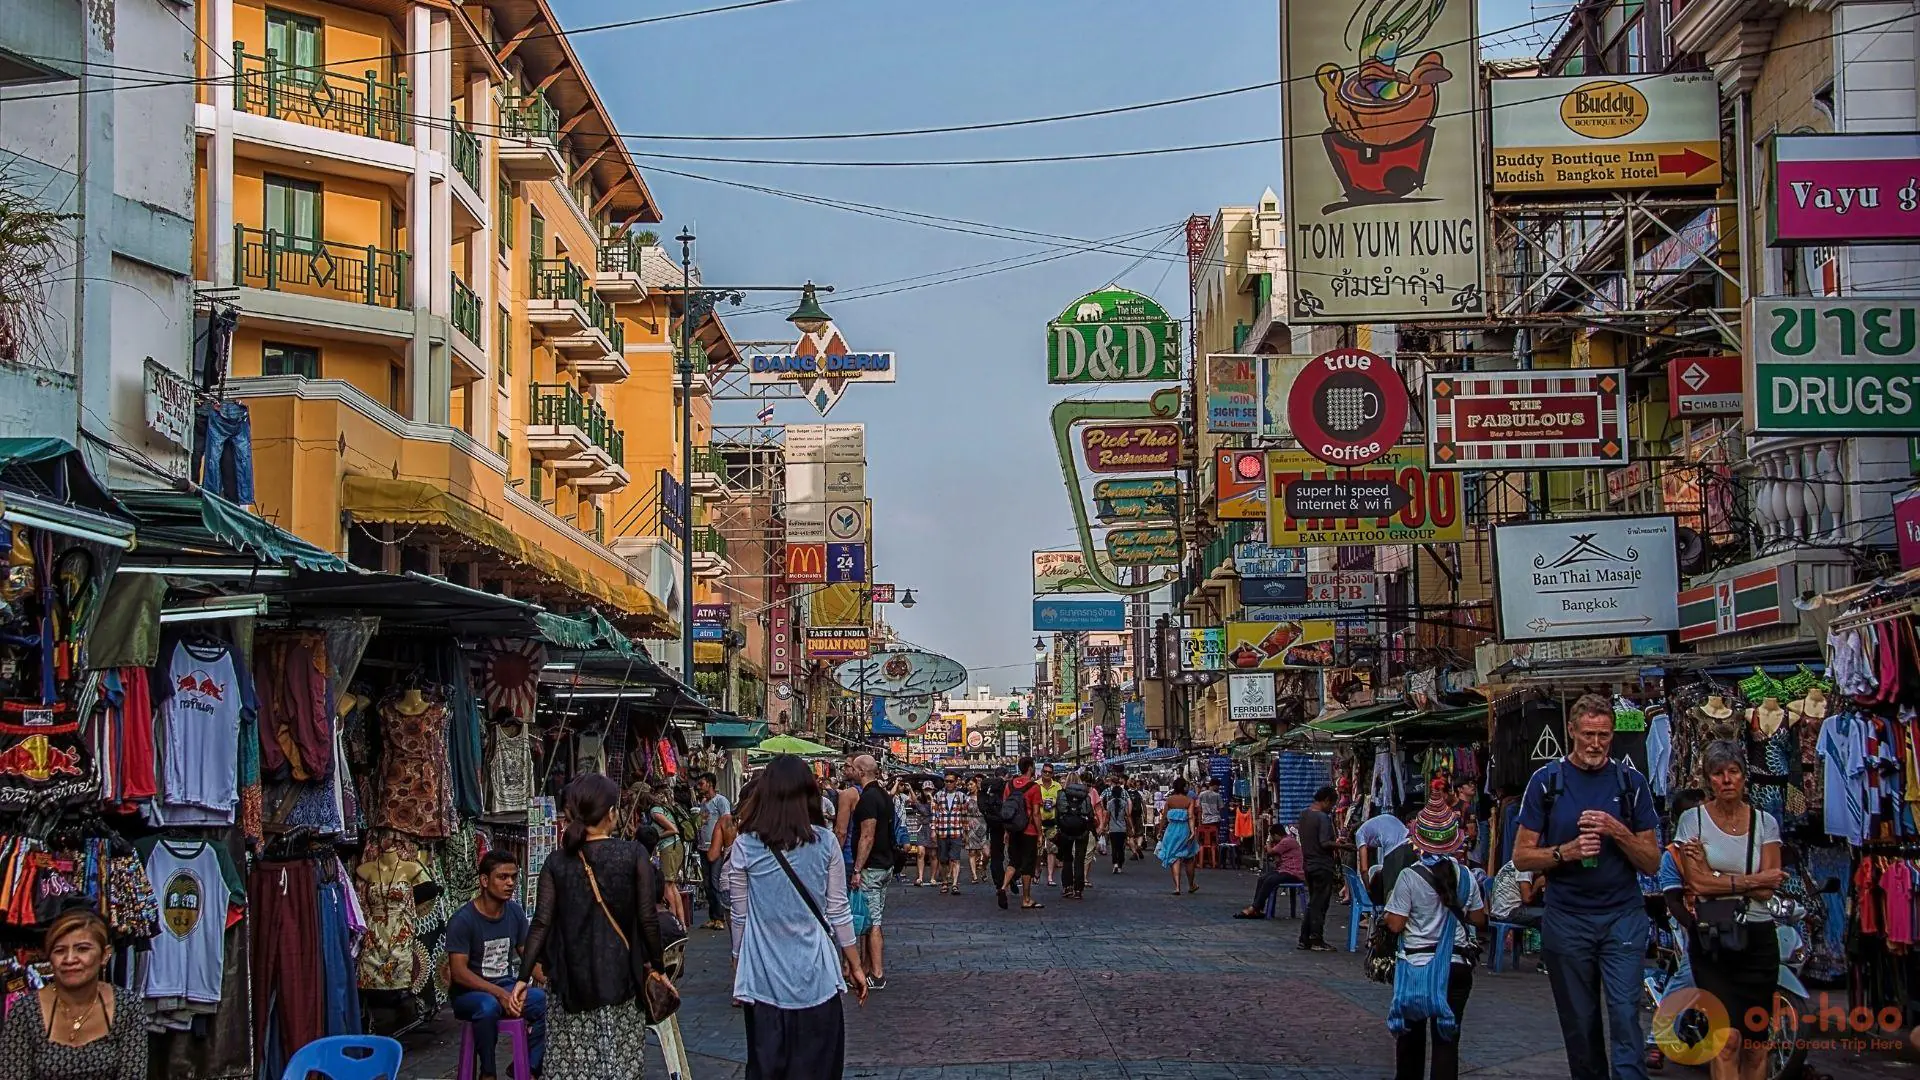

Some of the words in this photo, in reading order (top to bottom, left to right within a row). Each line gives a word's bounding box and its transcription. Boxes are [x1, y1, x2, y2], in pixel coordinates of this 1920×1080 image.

[1575, 91, 1635, 117] Buddy
[1575, 118, 1617, 127] BOUTIQUE
[1620, 118, 1635, 126] INN
[1496, 154, 1545, 168] Buddy
[1551, 152, 1621, 168] Boutique
[1628, 151, 1655, 163] Inn
[1496, 171, 1545, 183] Modish
[1557, 168, 1615, 183] Bangkok
[1621, 167, 1658, 179] Hotel
[1790, 181, 1880, 214] Vayu
[1898, 177, 1920, 211] g
[1298, 223, 1345, 260] TOM
[1352, 221, 1400, 258] YUM
[1409, 218, 1474, 256] KUNG
[1331, 266, 1445, 306] ต้มยำกุ้ง
[1117, 305, 1129, 315] The
[1131, 305, 1144, 315] best
[1770, 307, 1916, 357] ขาย
[1053, 325, 1156, 380] D&D
[1163, 324, 1177, 374] INN
[753, 355, 817, 372] DANG
[827, 353, 890, 372] DERM
[1324, 355, 1371, 371] true
[780, 371, 818, 379] Authentic
[1229, 395, 1250, 405] JOIN
[1772, 376, 1920, 415] DRUGS
[1213, 407, 1241, 417] SIGHT
[1509, 400, 1542, 411] THE
[1693, 400, 1718, 409] CIMB
[1719, 400, 1740, 409] THAI
[1467, 412, 1586, 428] FABULOUS
[1087, 429, 1178, 449] Pick-Thai
[1099, 449, 1169, 465] Restaurant
[1321, 441, 1381, 461] coffee
[1296, 486, 1332, 498] super
[1335, 484, 1347, 496] hi
[1351, 484, 1389, 498] speed
[1296, 498, 1346, 510] internet
[1350, 499, 1359, 510] &
[1364, 499, 1379, 510] wi
[1384, 498, 1392, 509] fi
[1299, 532, 1326, 543] EAK
[1330, 531, 1385, 542] TATTOO
[1389, 529, 1436, 541] GROUP
[837, 556, 854, 569] 24
[1036, 554, 1082, 565] CENTER
[1037, 564, 1072, 578] Khao
[1532, 572, 1557, 586] Ban
[1560, 568, 1590, 585] Thai
[1596, 566, 1642, 585] Masaje
[1320, 588, 1331, 600] &
[1307, 601, 1333, 609] SILVER
[1334, 600, 1352, 608] SHOP
[1562, 597, 1619, 613] Bangkok
[697, 609, 717, 618] ATM
[1060, 607, 1116, 618] ธนาคารกรุงไทย
[775, 618, 786, 671] FOOD
[808, 639, 841, 650] INDIAN
[843, 638, 867, 650] FOOD
[847, 662, 887, 689] The
[904, 667, 959, 688] Club
[925, 732, 946, 740] BAG
